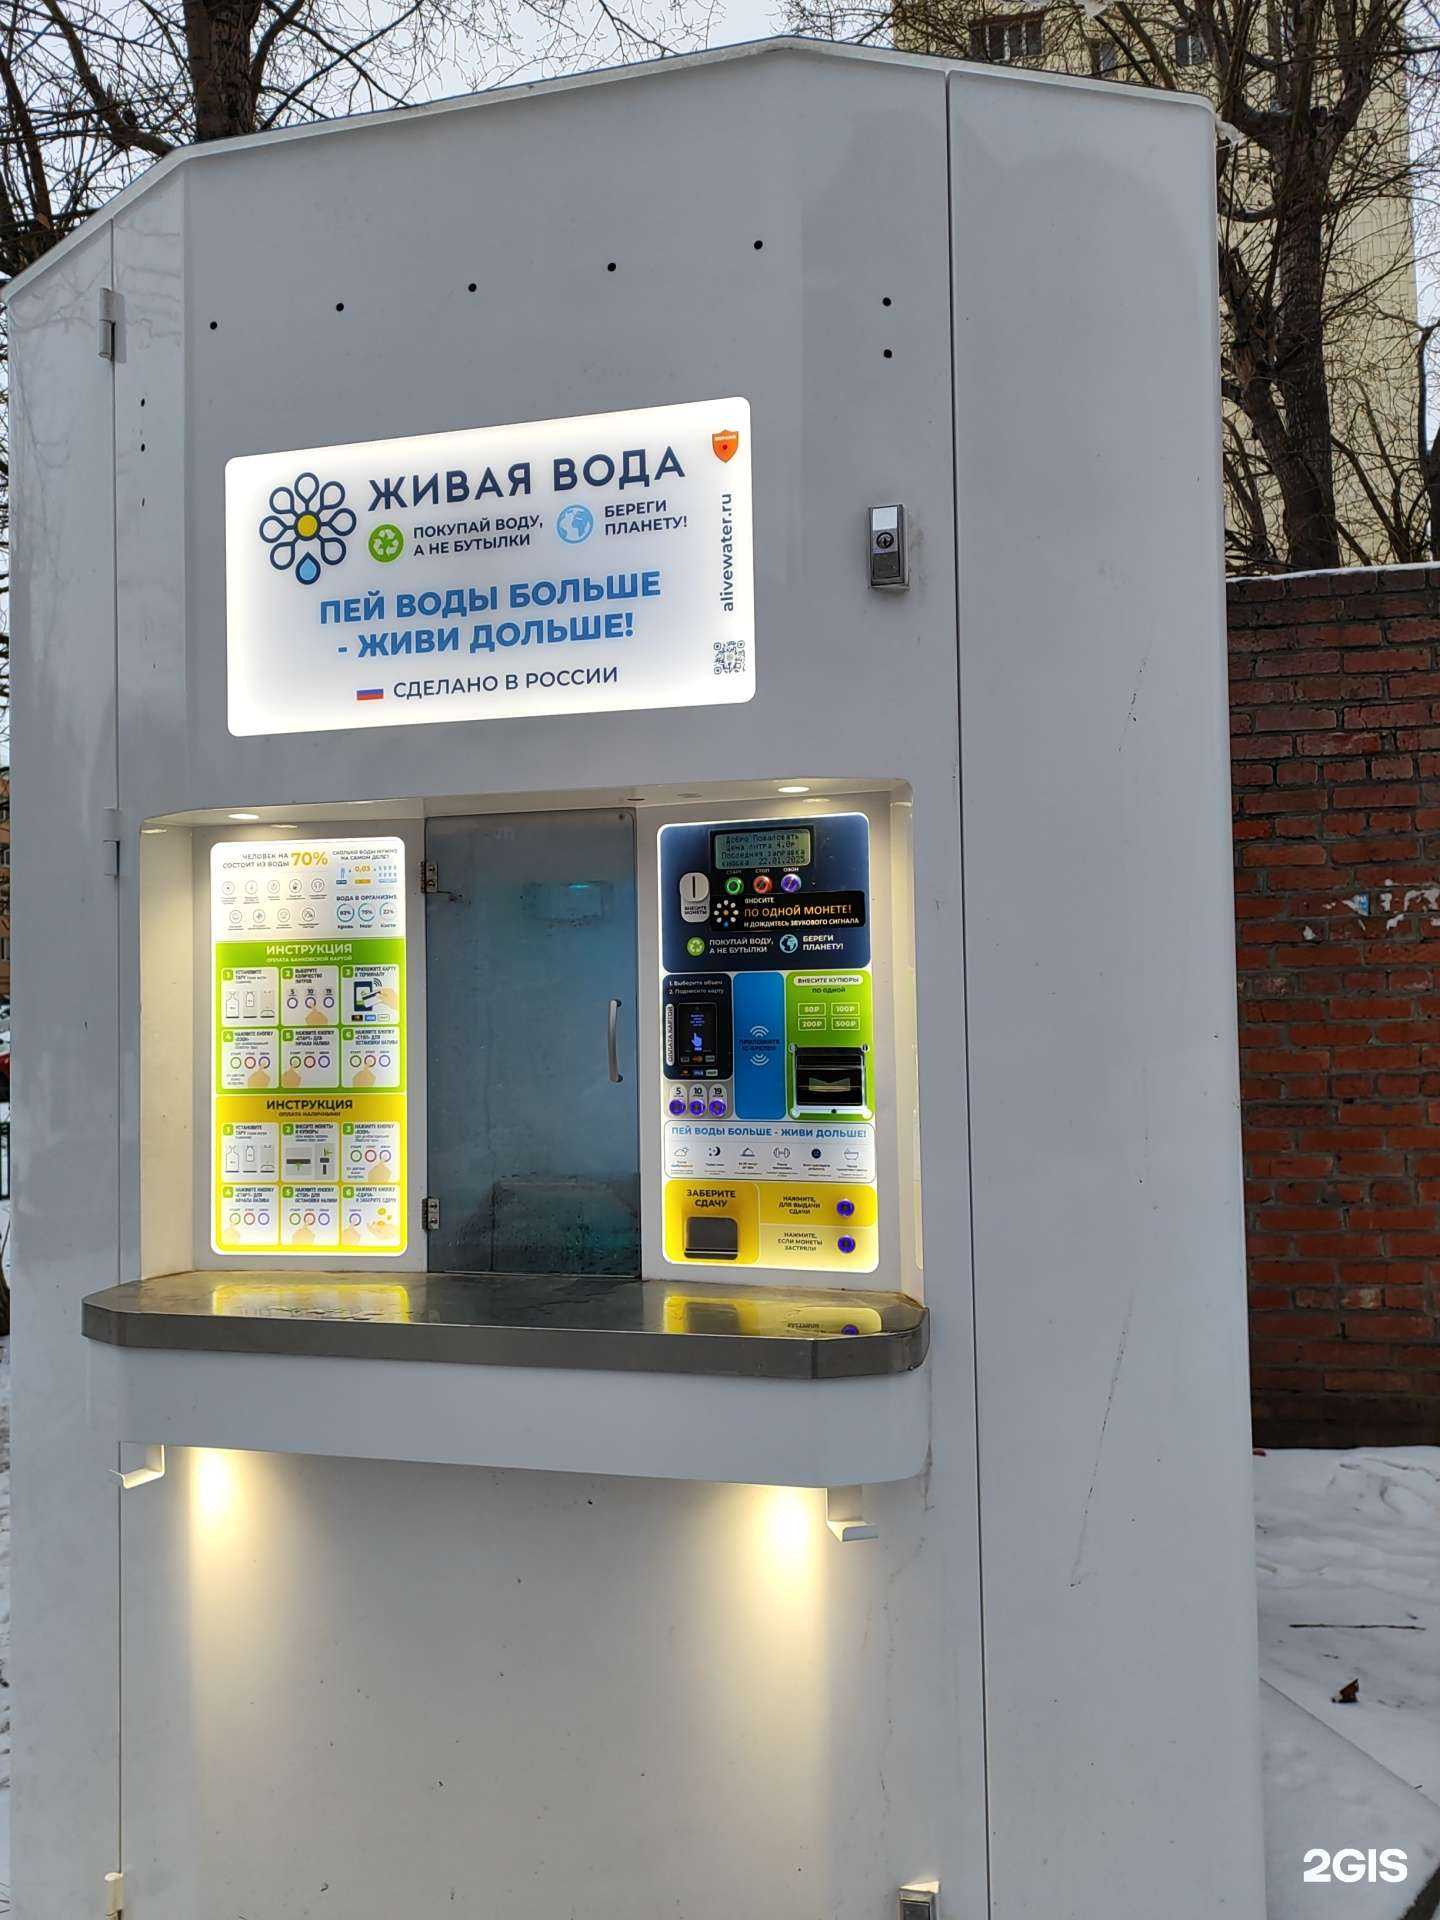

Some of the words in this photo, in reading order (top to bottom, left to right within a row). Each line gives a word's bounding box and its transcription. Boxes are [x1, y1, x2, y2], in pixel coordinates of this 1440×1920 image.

[368, 462, 532, 512] ЖИВАЯ
[553, 446, 686, 492] ВОДА
[604, 499, 667, 518] БЕРЕГИ
[413, 518, 491, 540] ПОКУПАЙ
[495, 514, 543, 532] ВОДУ,
[605, 515, 688, 536] ПЛАНЕТУ!
[413, 543, 425, 557] А
[429, 541, 450, 555] НЕ
[454, 534, 531, 553] БУТЫЛКИ
[720, 493, 734, 612] alivewater.ru
[320, 590, 385, 624] ПЕЙ
[396, 586, 498, 618] ВОДЫ
[509, 570, 661, 609] БОЛЬШЕ
[357, 627, 459, 658] ЖИВИ
[469, 612, 634, 654] ДОЛЬШЕ!
[393, 675, 499, 700] СДЕЛАНО
[505, 674, 519, 690] В
[525, 666, 618, 689] РОССИИ
[290, 852, 328, 866] 70%
[744, 908, 759, 917] ПО
[762, 904, 801, 917] ОДНОЙ
[804, 904, 852, 915] МОНЕТЕ!
[709, 936, 748, 946] ПОКУПАЙ
[749, 937, 774, 945] ВОДУ,
[802, 943, 844, 951] ПЛАНЕТУ!
[266, 943, 353, 955] ИНСТРУКЦИЯ
[675, 1087, 682, 1095] 5
[694, 1087, 703, 1095] 10
[713, 1087, 722, 1095] 19
[266, 1099, 353, 1111] ИНСТРУКЦИЯ
[671, 1125, 692, 1135] ПЕЙ
[694, 1127, 725, 1136] ВОДЫ
[728, 1127, 772, 1137] БОЛЬШЕ
[781, 1128, 813, 1137] ЖИВИ
[815, 1129, 867, 1138] ДОЛЬШЕ!
[686, 1189, 736, 1198] ЗАБЕРИТЕ
[694, 1199, 728, 1208] СДАЧУ
